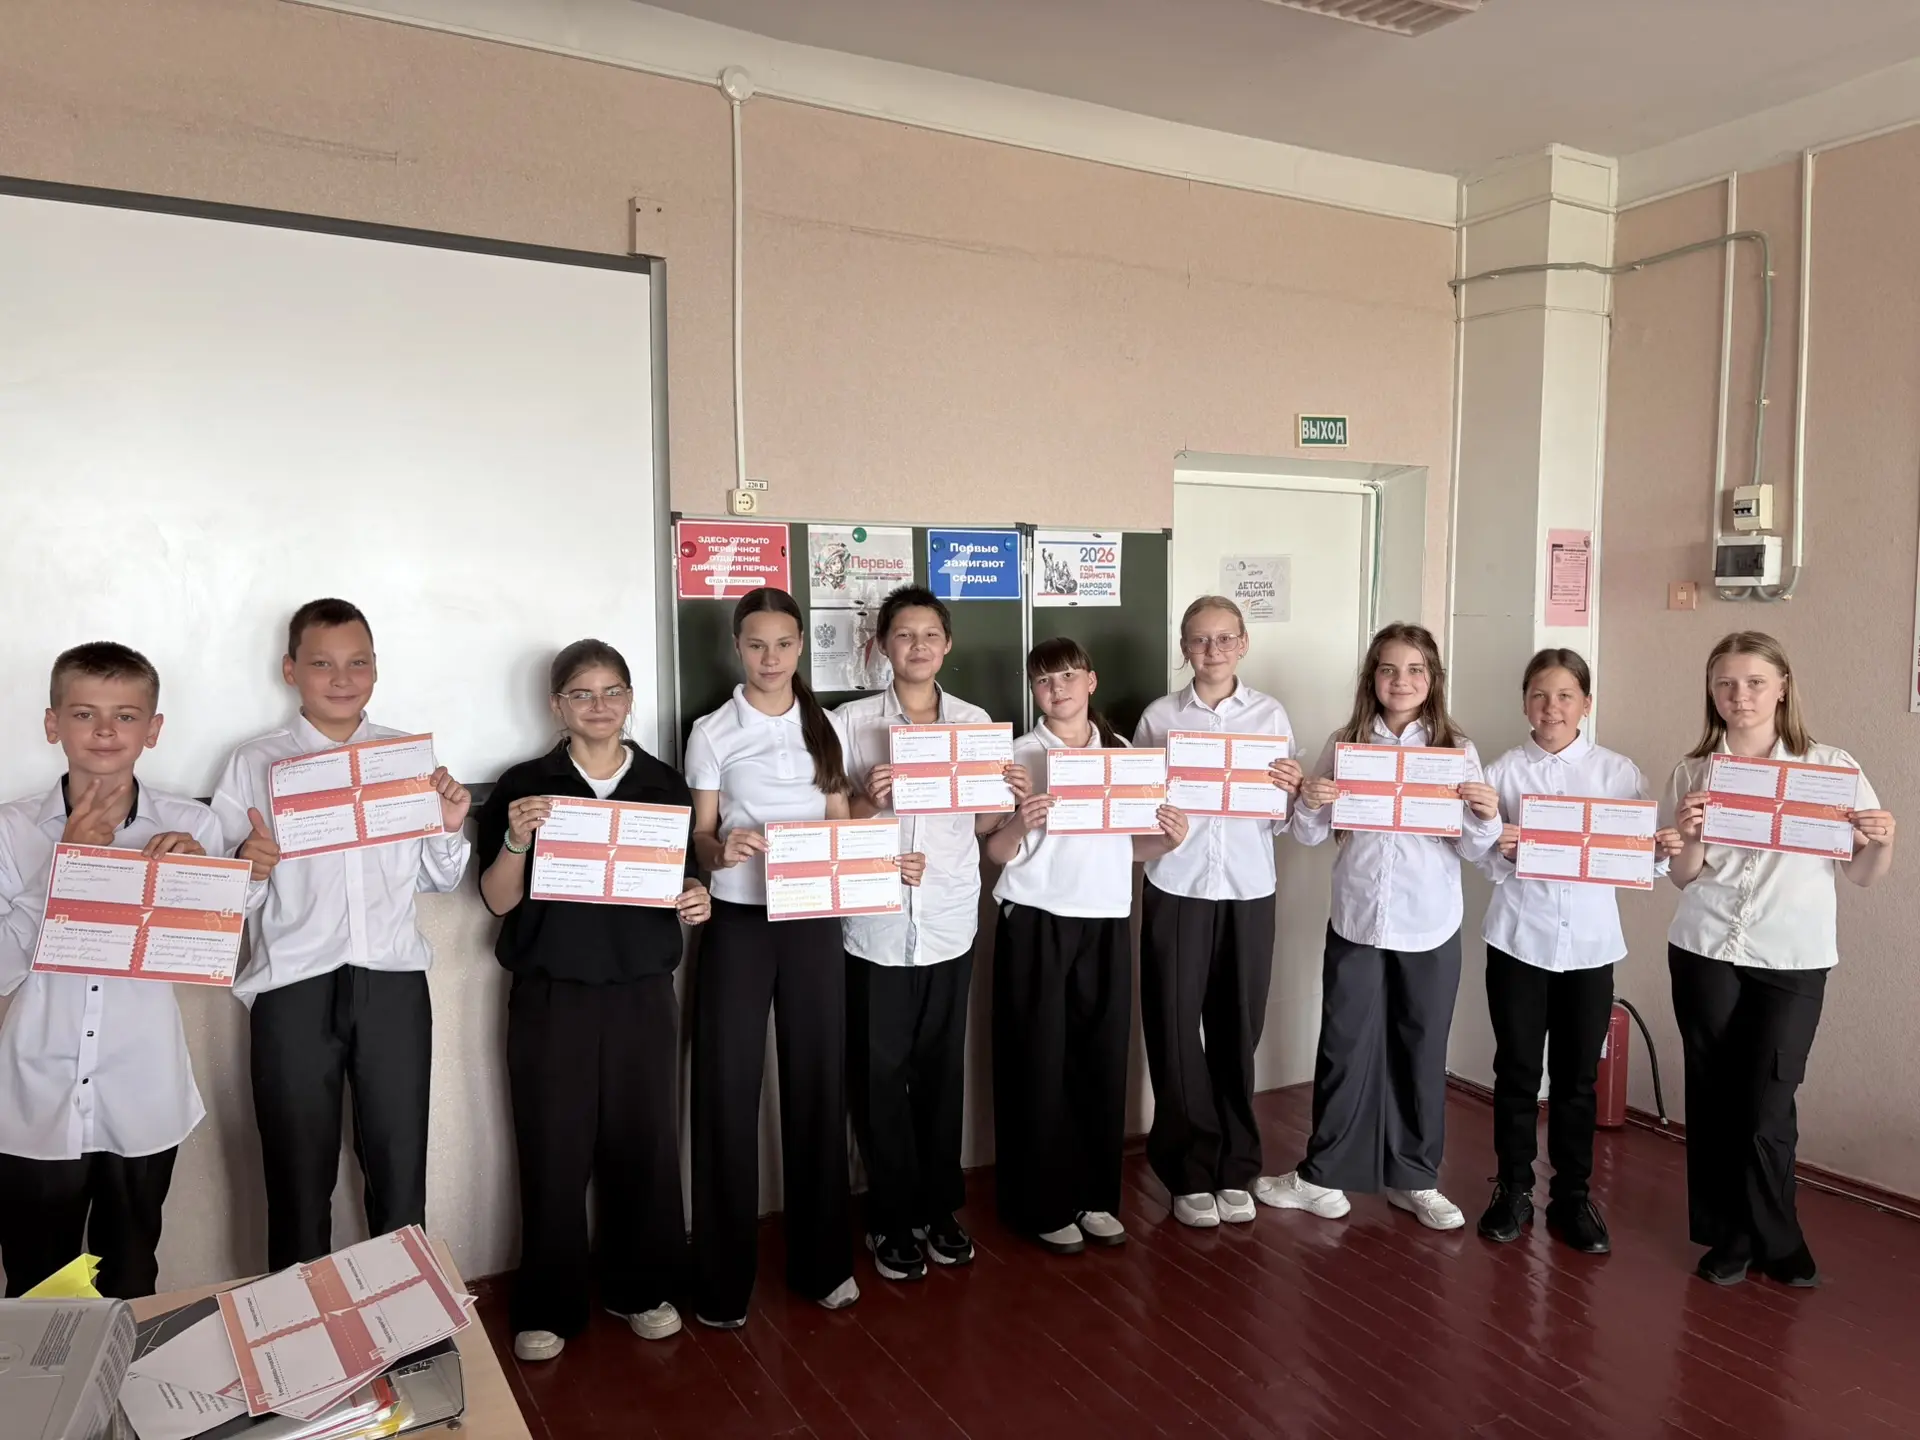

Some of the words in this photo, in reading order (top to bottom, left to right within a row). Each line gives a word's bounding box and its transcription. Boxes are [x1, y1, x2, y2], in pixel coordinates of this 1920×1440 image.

[1303, 420, 1345, 444] ВЫХОД
[698, 536, 728, 544] ЗДЕСЬ
[729, 536, 770, 545] ОТКРЫТО
[708, 545, 761, 553] ПЕРВИЧНОЕ
[950, 542, 999, 555] Первые
[709, 555, 760, 563] ОТДЕЛЕНИЕ
[1080, 547, 1116, 564] 2026
[690, 564, 742, 572] ДВИЖЕНИЯ
[851, 555, 904, 573] Первые
[944, 559, 1006, 569] зажигают
[1080, 565, 1094, 573] ГОД
[952, 574, 998, 584] сердца
[1080, 572, 1116, 580] ЕДИНСТВА
[1238, 581, 1273, 590] ДЕТСКИХ
